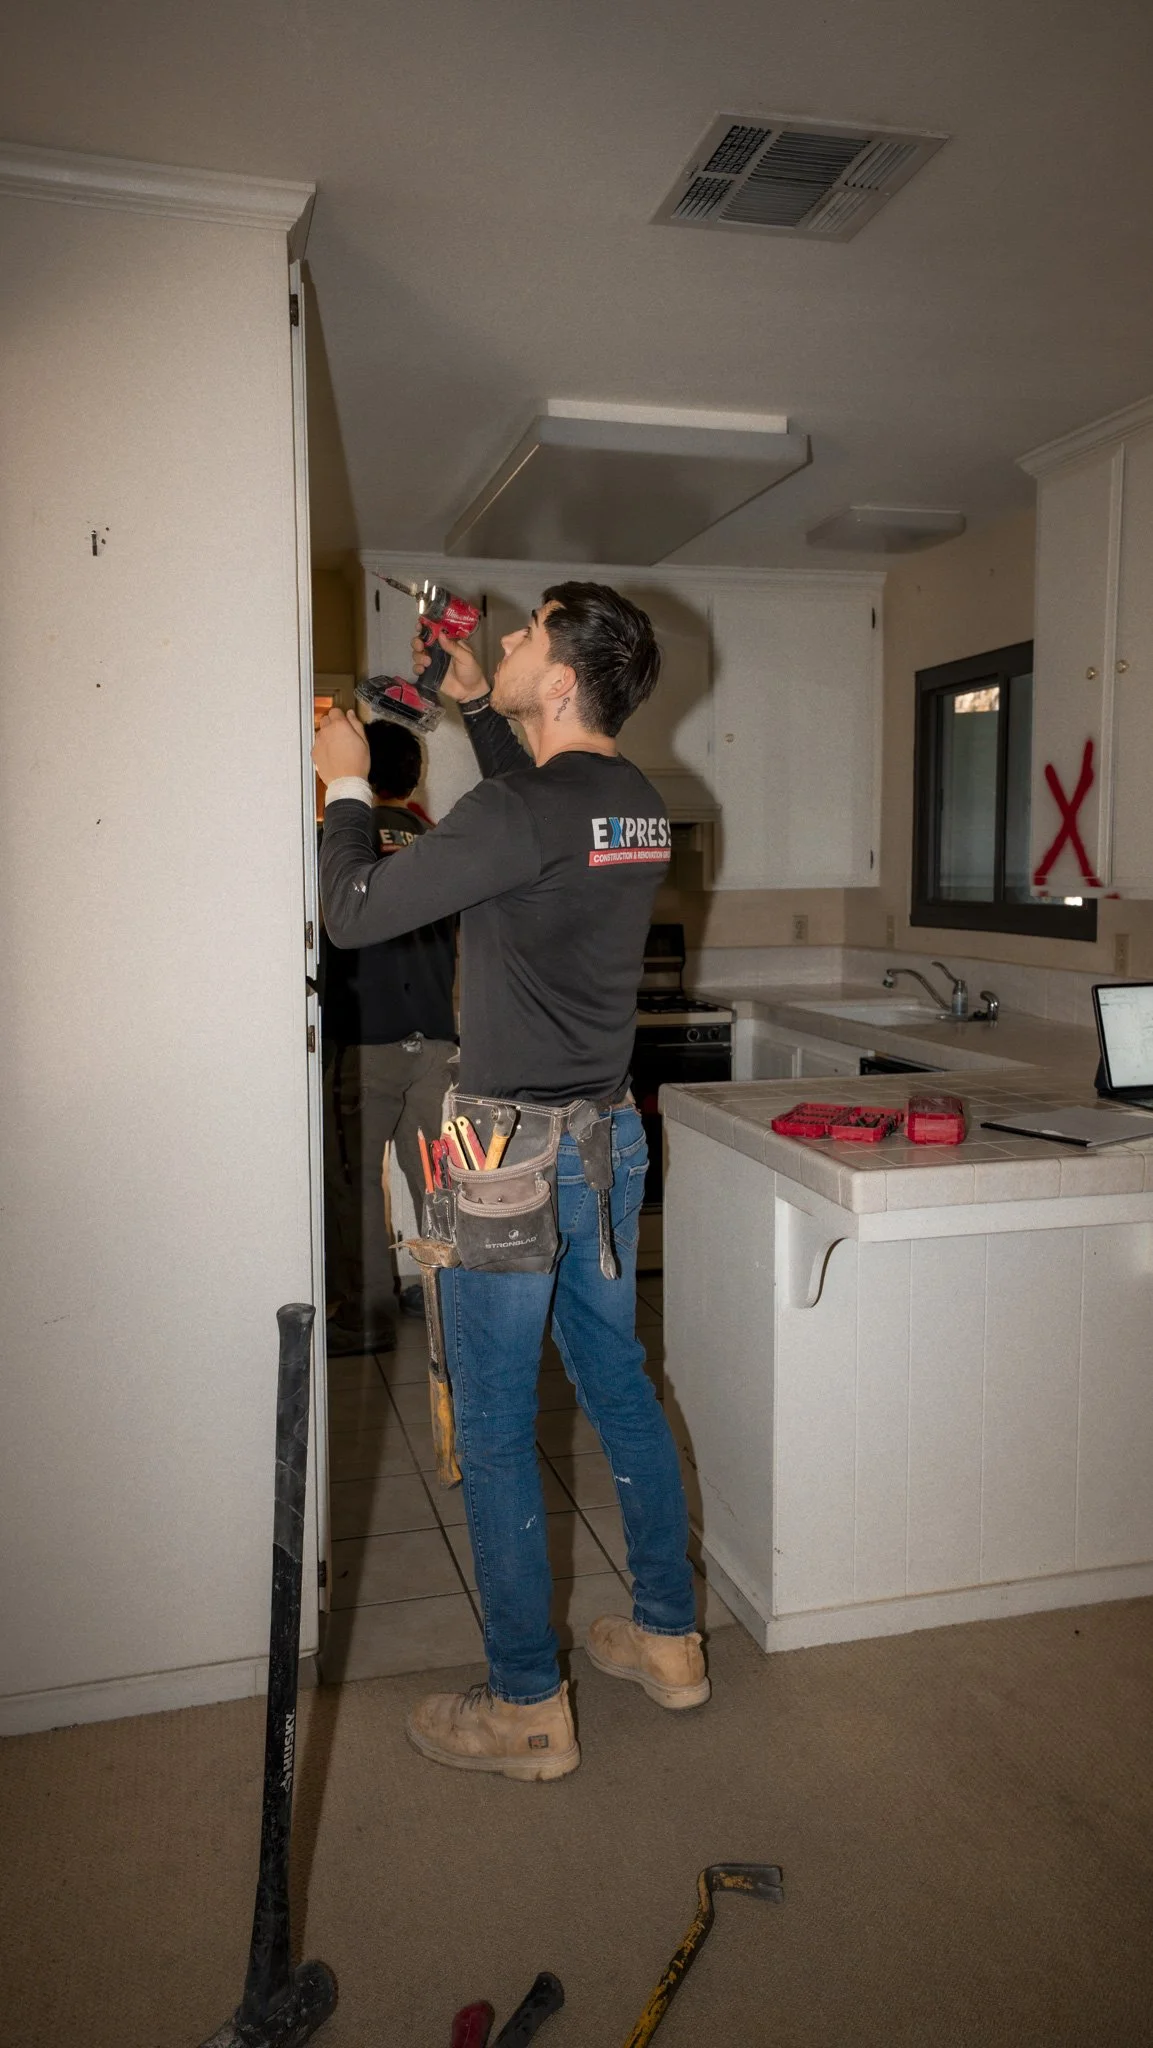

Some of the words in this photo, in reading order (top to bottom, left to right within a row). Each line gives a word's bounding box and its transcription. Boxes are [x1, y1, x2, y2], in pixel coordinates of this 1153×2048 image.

[378, 828, 417, 846] EXP
[593, 851, 632, 863] CONSTRUCTION
[282, 1713, 296, 1772] HUSKY
